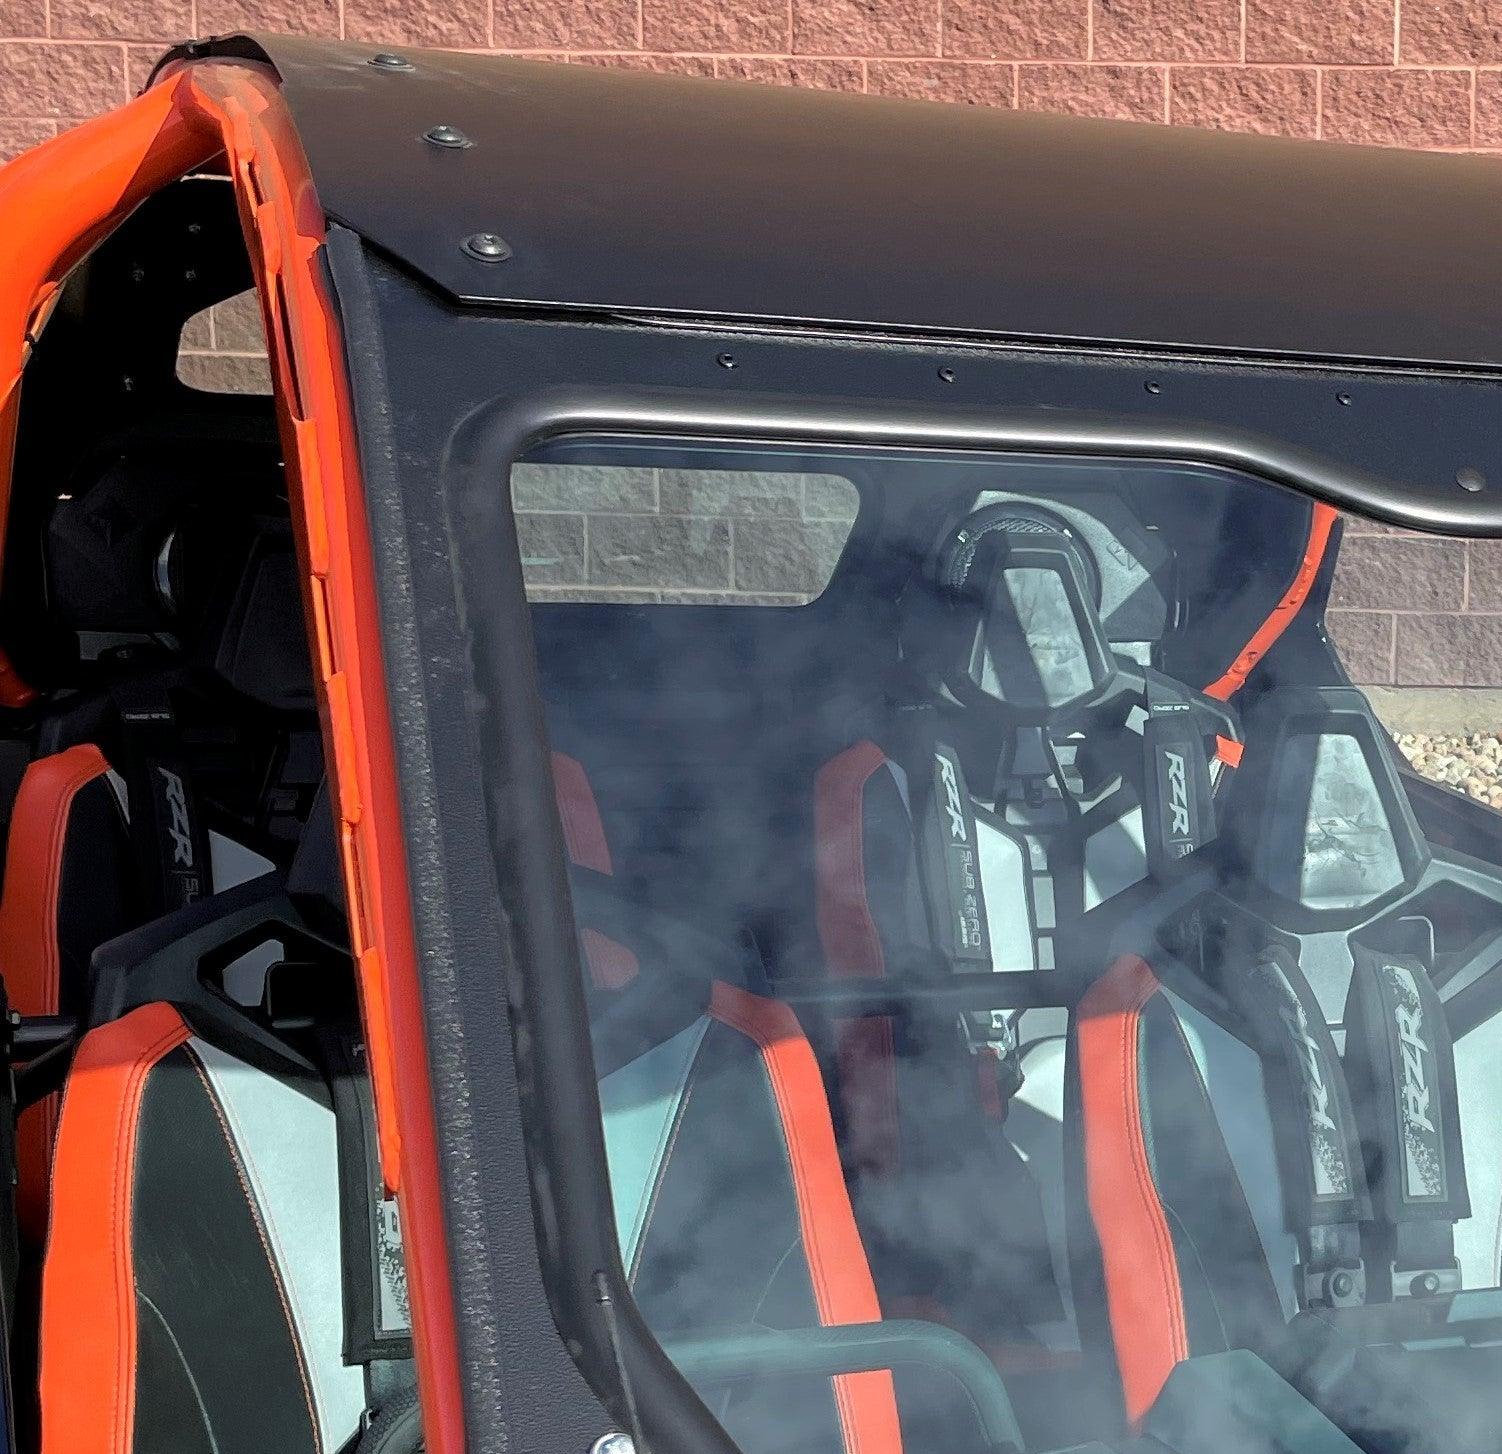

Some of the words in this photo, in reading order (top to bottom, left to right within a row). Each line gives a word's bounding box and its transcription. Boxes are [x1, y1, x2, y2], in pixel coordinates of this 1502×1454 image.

[158, 767, 194, 868] RZR
[935, 753, 967, 842] RZR
[1165, 751, 1190, 836] RZR
[1279, 1006, 1336, 1131] RZR
[1395, 1004, 1435, 1133] RZR
